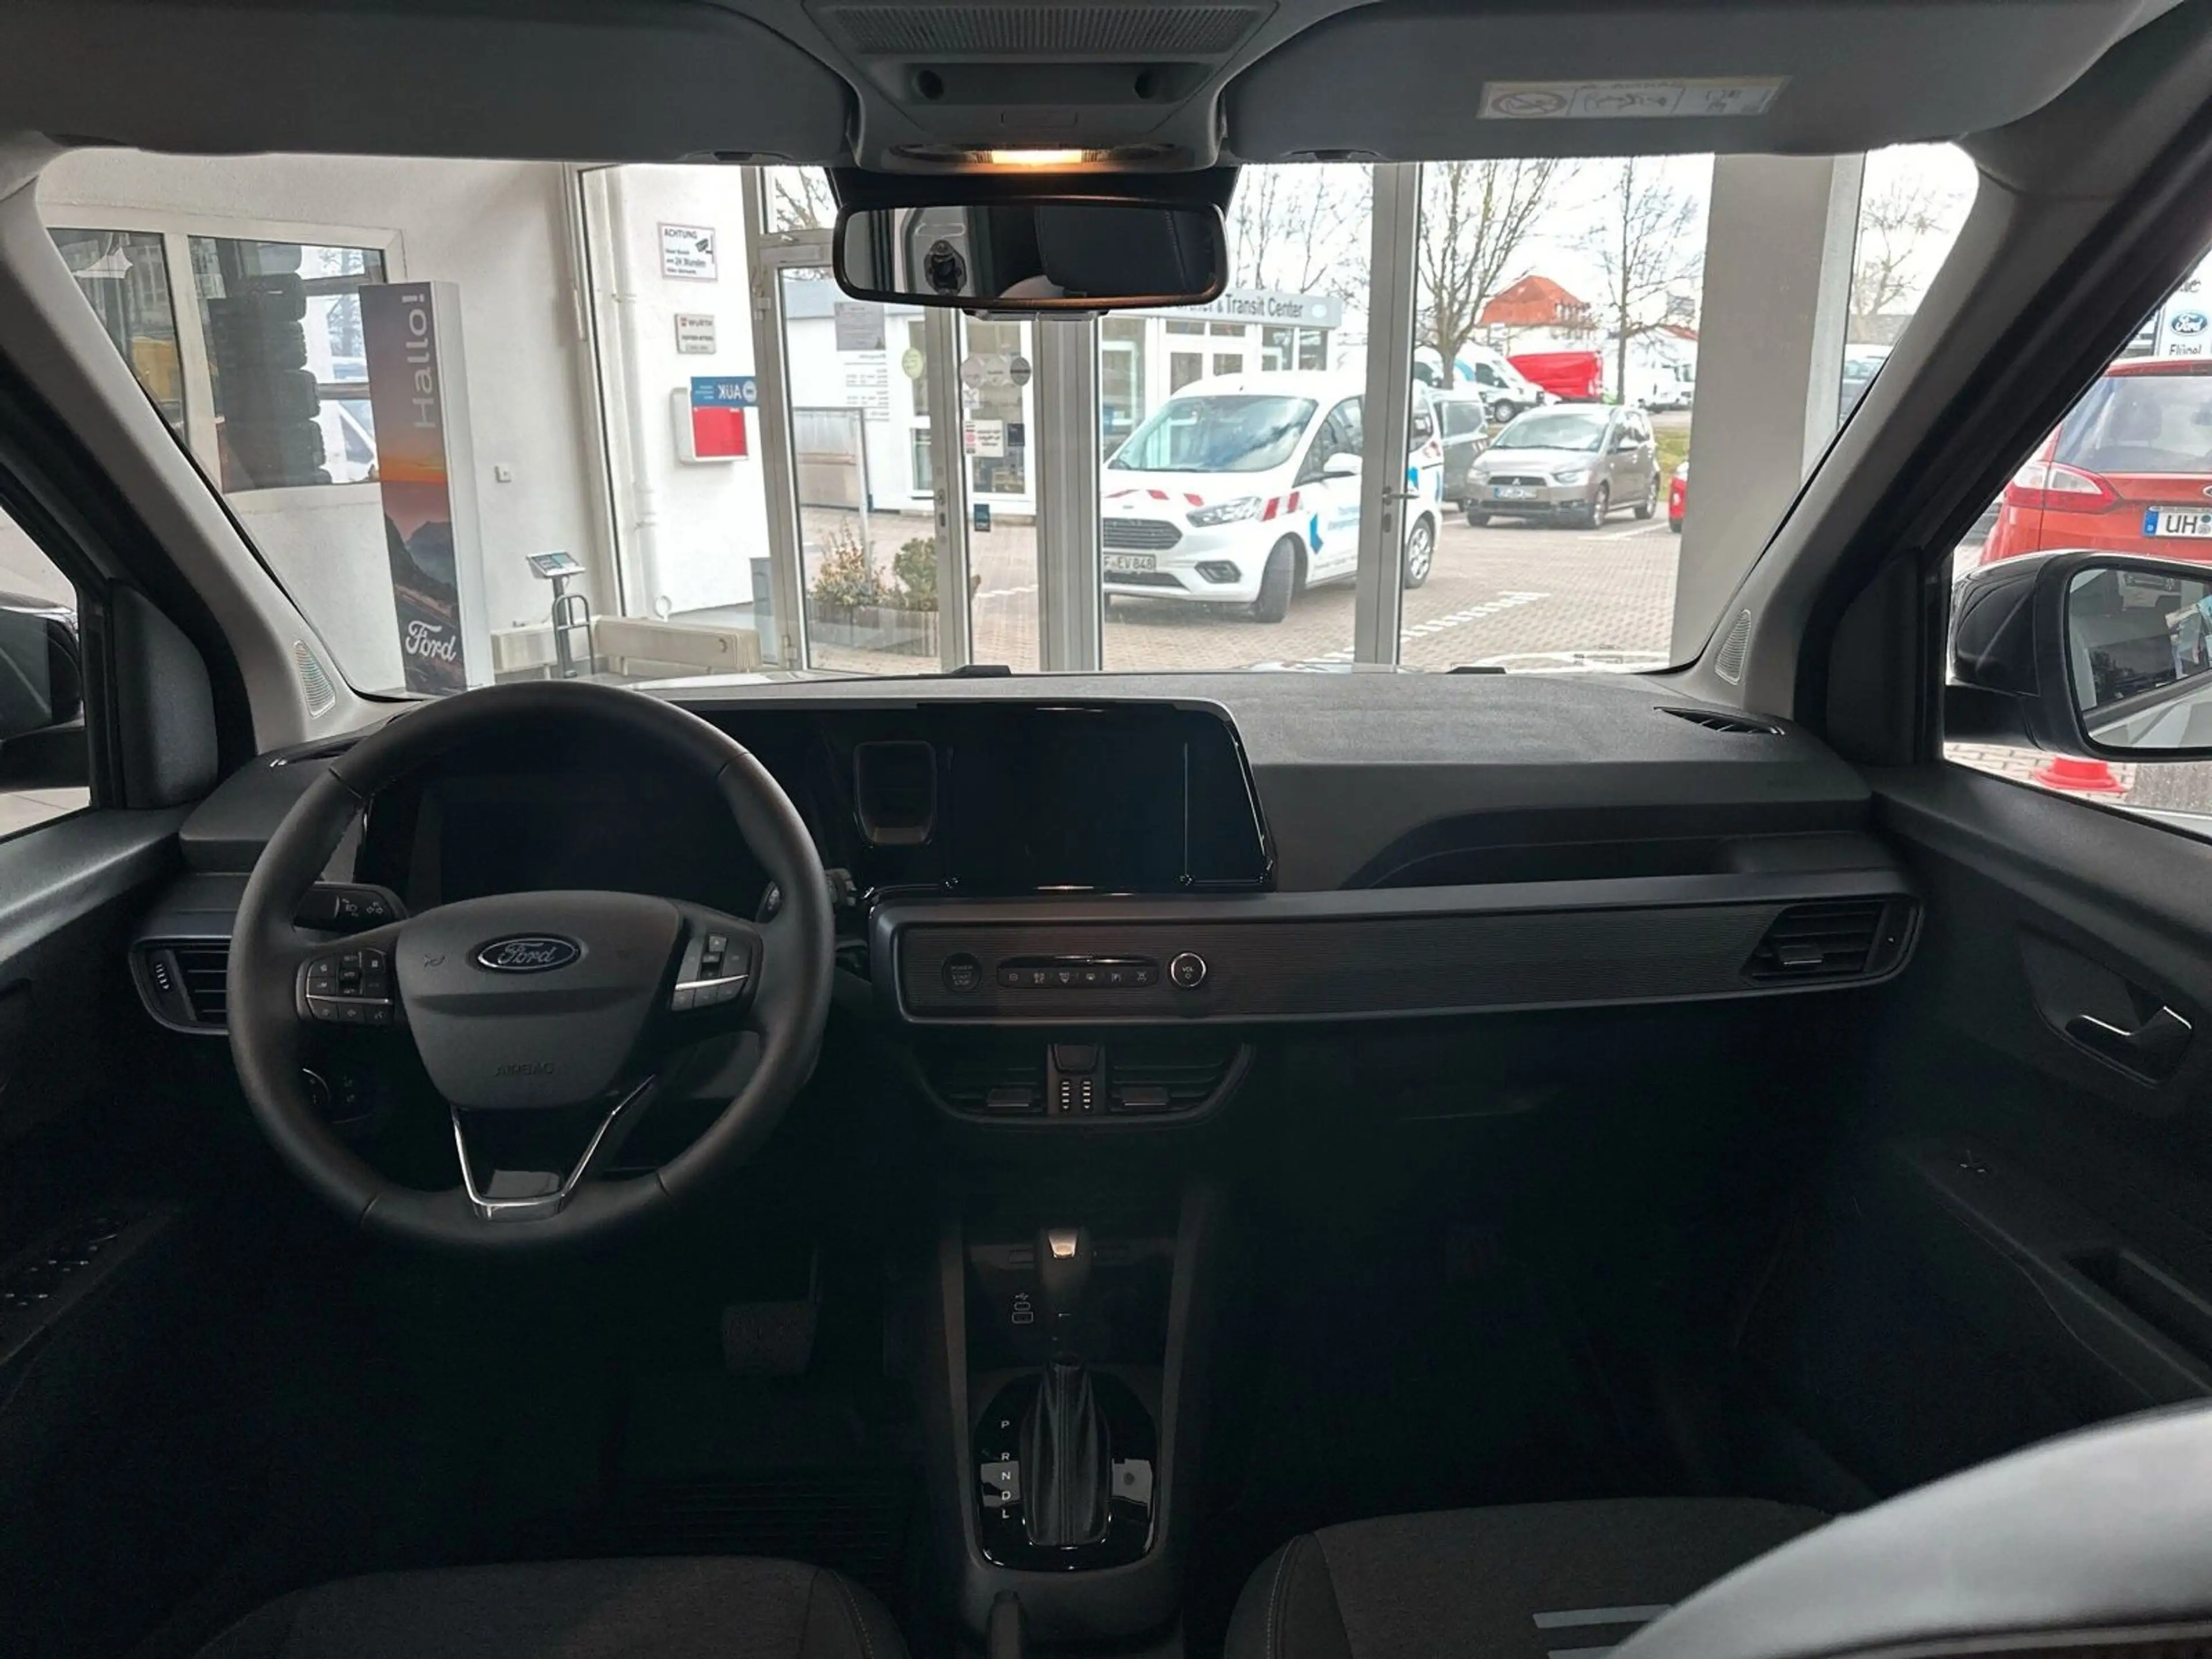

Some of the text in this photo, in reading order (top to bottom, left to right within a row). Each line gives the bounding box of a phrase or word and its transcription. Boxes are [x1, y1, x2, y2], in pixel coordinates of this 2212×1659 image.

[1225, 294, 1265, 316] Transit
[1267, 297, 1304, 318] Center
[402, 293, 437, 428] Hallo!
[2166, 514, 2198, 534] UH
[406, 620, 457, 662] Ford
[498, 942, 558, 964] Ford
[1001, 1421, 1010, 1429] P
[1001, 1453, 1010, 1461] R
[1002, 1472, 1011, 1480] N
[1002, 1491, 1011, 1501] D
[1002, 1510, 1009, 1518] L
